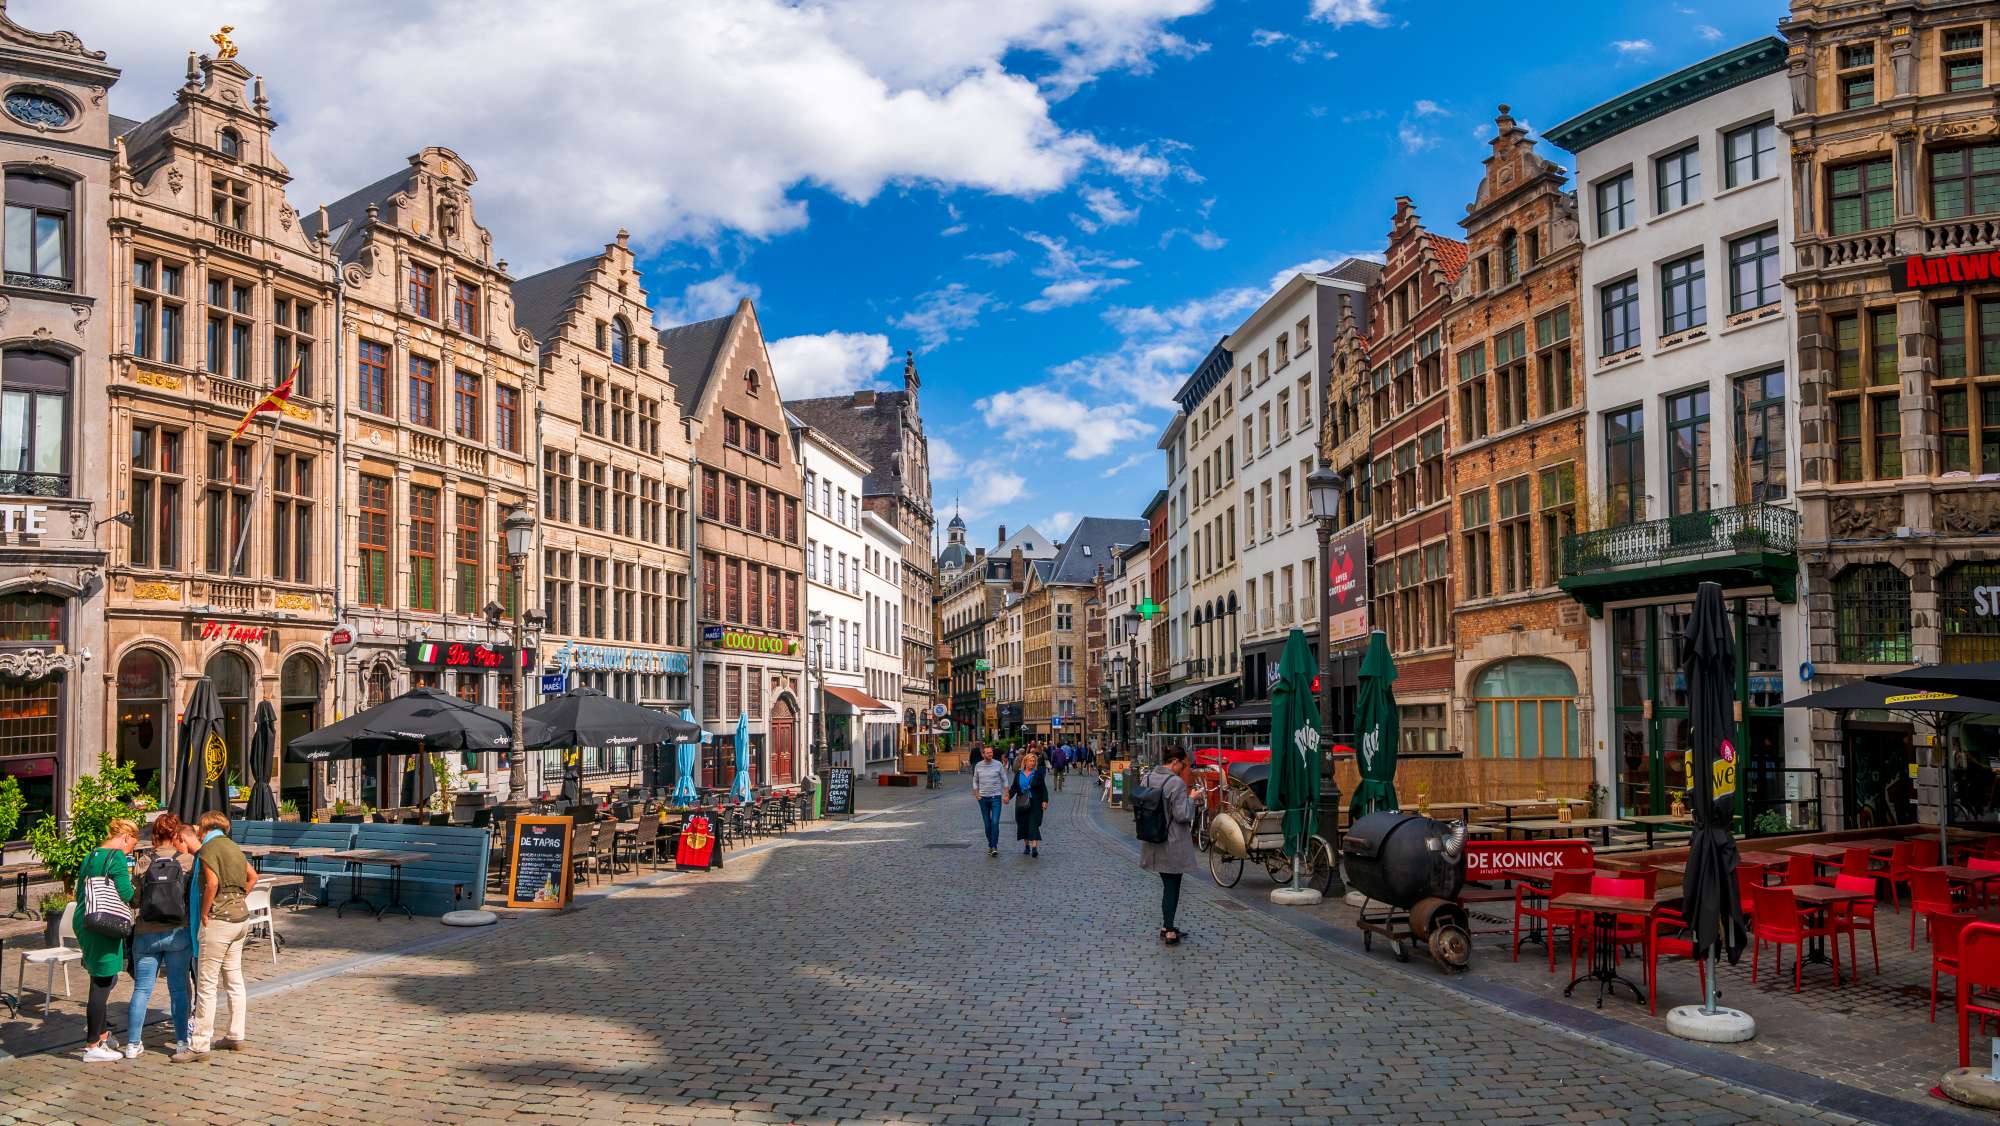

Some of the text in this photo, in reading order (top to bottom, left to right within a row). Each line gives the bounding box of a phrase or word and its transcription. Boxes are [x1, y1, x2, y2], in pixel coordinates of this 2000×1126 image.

[726, 632, 783, 652] COCO LOCO
[447, 643, 470, 666] Da
[543, 683, 560, 691] MAES
[520, 836, 561, 848] DE TAPAS
[1467, 851, 1564, 869] DE KONINCK
